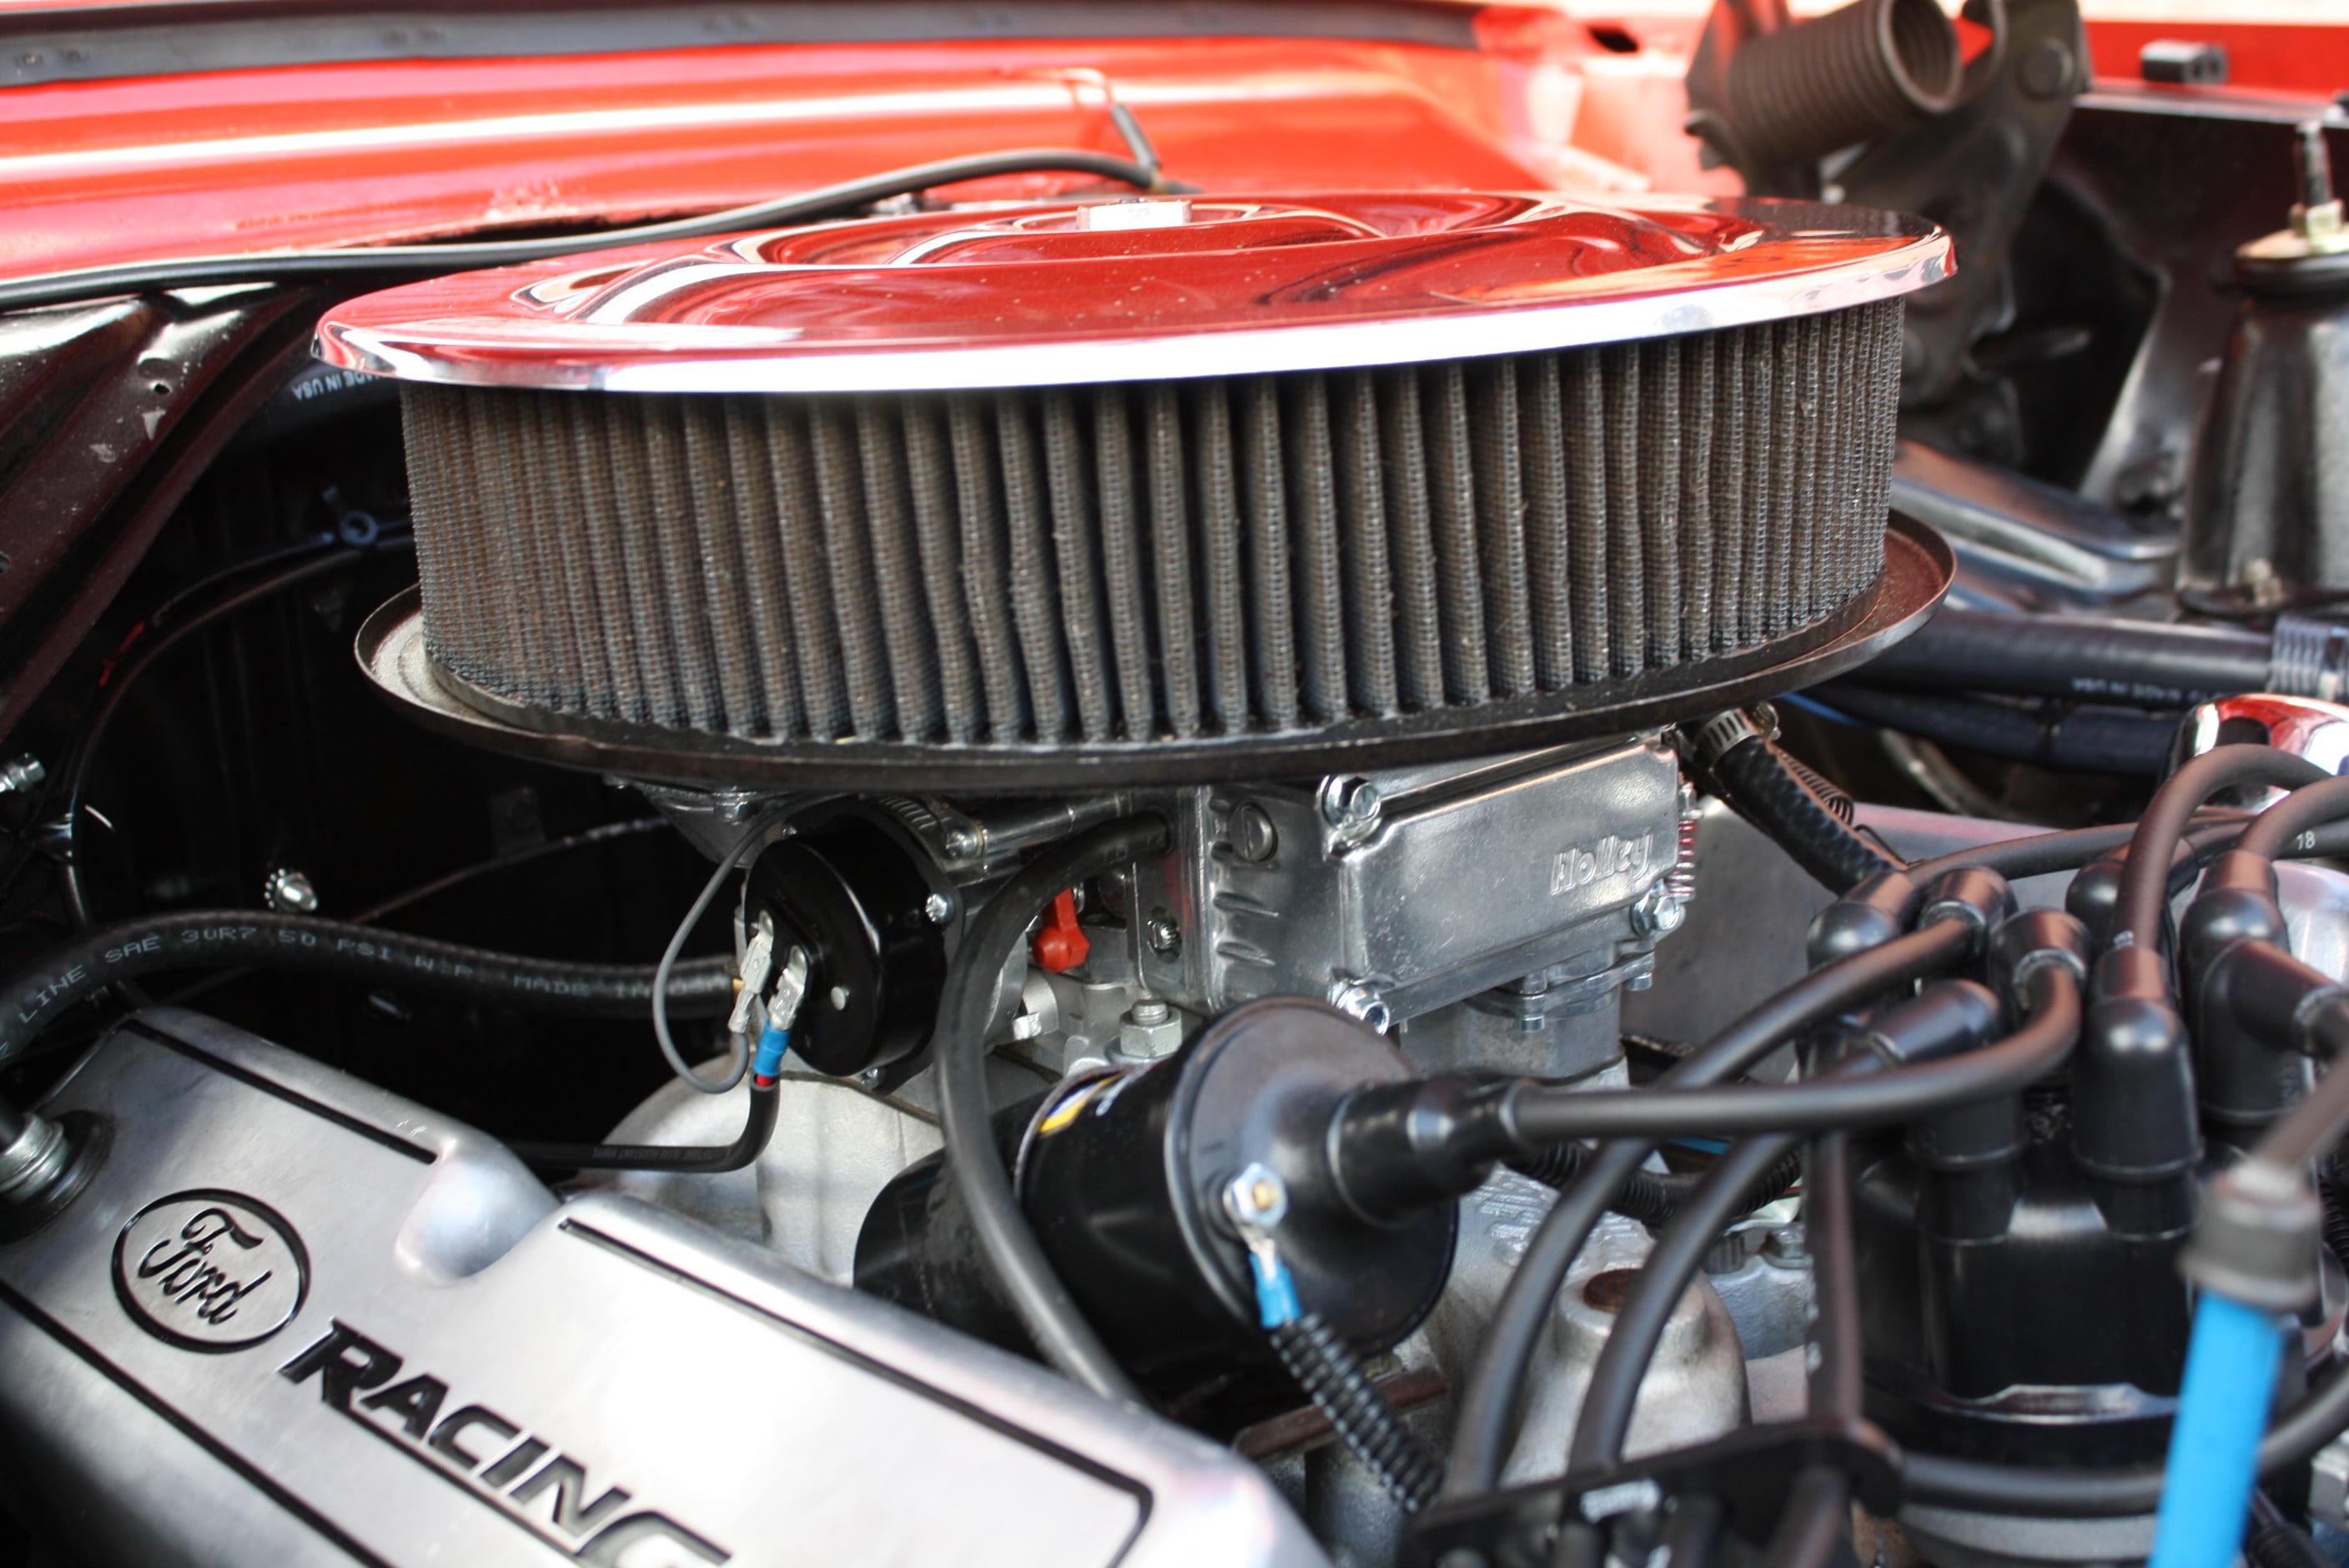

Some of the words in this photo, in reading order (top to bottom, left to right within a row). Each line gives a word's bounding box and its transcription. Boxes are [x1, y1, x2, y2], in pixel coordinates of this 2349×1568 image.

[293, 378, 324, 400] USA
[325, 373, 342, 393] IN
[343, 370, 381, 388] DE
[2296, 830, 2316, 850] 18
[1550, 832, 1654, 897] Holley
[18, 964, 87, 1023] LINE
[105, 935, 160, 962] SAE
[337, 938, 390, 960] PSI
[513, 974, 589, 998] MADE
[615, 979, 651, 999] IN
[138, 1208, 273, 1324] Ford
